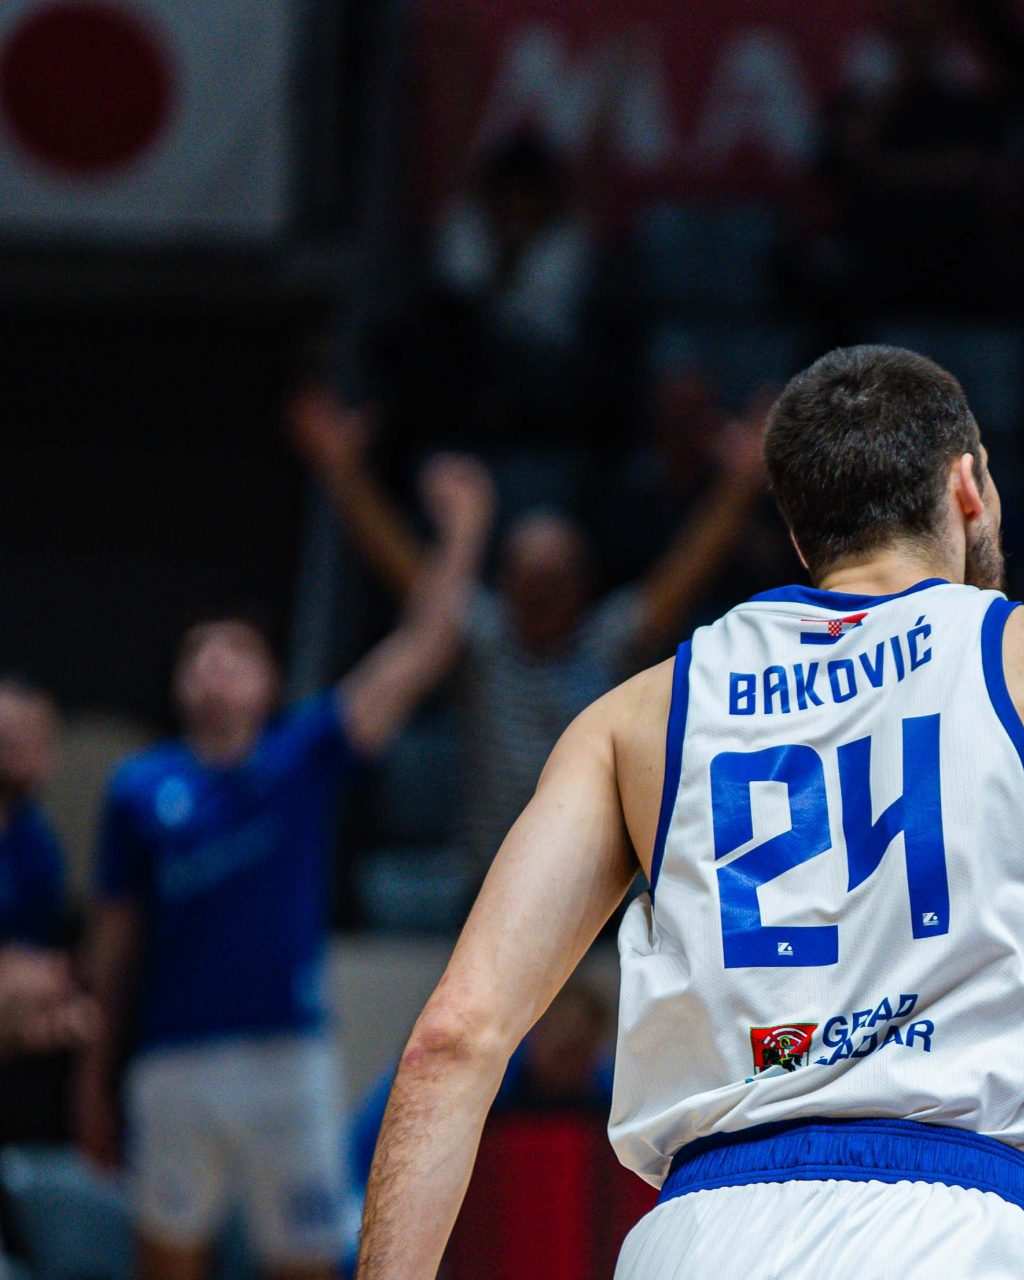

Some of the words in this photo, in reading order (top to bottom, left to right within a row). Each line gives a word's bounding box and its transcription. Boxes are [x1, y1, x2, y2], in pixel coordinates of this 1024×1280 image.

[729, 615, 933, 716] BAKOVIĆ
[709, 713, 950, 969] 24
[815, 1019, 936, 1066] ADAR
